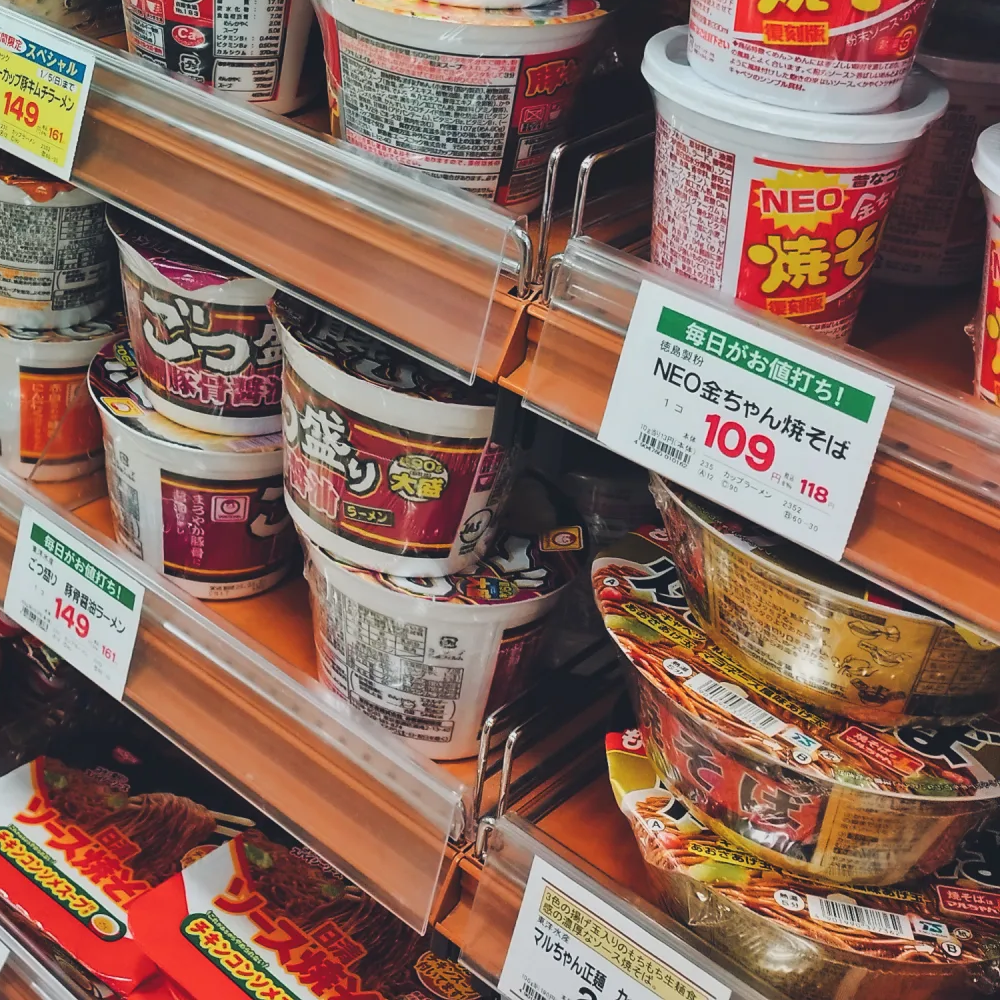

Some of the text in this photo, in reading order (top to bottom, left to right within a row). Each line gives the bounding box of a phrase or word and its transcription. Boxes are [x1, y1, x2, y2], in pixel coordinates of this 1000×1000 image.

[177, 26, 199, 41] Ca
[765, 21, 828, 45] 復刻版
[26, 43, 78, 77] スペシャル
[4, 91, 39, 128] 149
[49, 127, 64, 144] 161
[759, 187, 843, 214] NEO
[660, 339, 704, 368] 徳島製粉
[684, 321, 845, 407] 毎日がお値打ち!
[653, 357, 852, 461] NEO金ちゃん焼そば
[703, 413, 776, 472] 109
[390, 471, 443, 499] 大盛
[722, 471, 773, 499] カップラーメン
[800, 479, 829, 504] 118
[346, 504, 389, 522] ラーメン
[783, 499, 803, 515] 2352
[463, 519, 483, 535] JAS
[43, 535, 122, 600] 毎日がお値打ち!
[28, 557, 126, 634] ごつ盛り 豚骨醤油ラーメン
[55, 598, 90, 639] 149
[101, 645, 116, 663] 161
[98, 826, 142, 859] 日清
[309, 923, 365, 964] 日清
[537, 915, 570, 943] 東洋水産
[533, 927, 608, 993] マルちゃん正麺
[543, 902, 657, 991] 感の濃厚なソース焼そば。
[545, 892, 698, 1000] 3色の揚げ玉入りのもちもち生麺食
